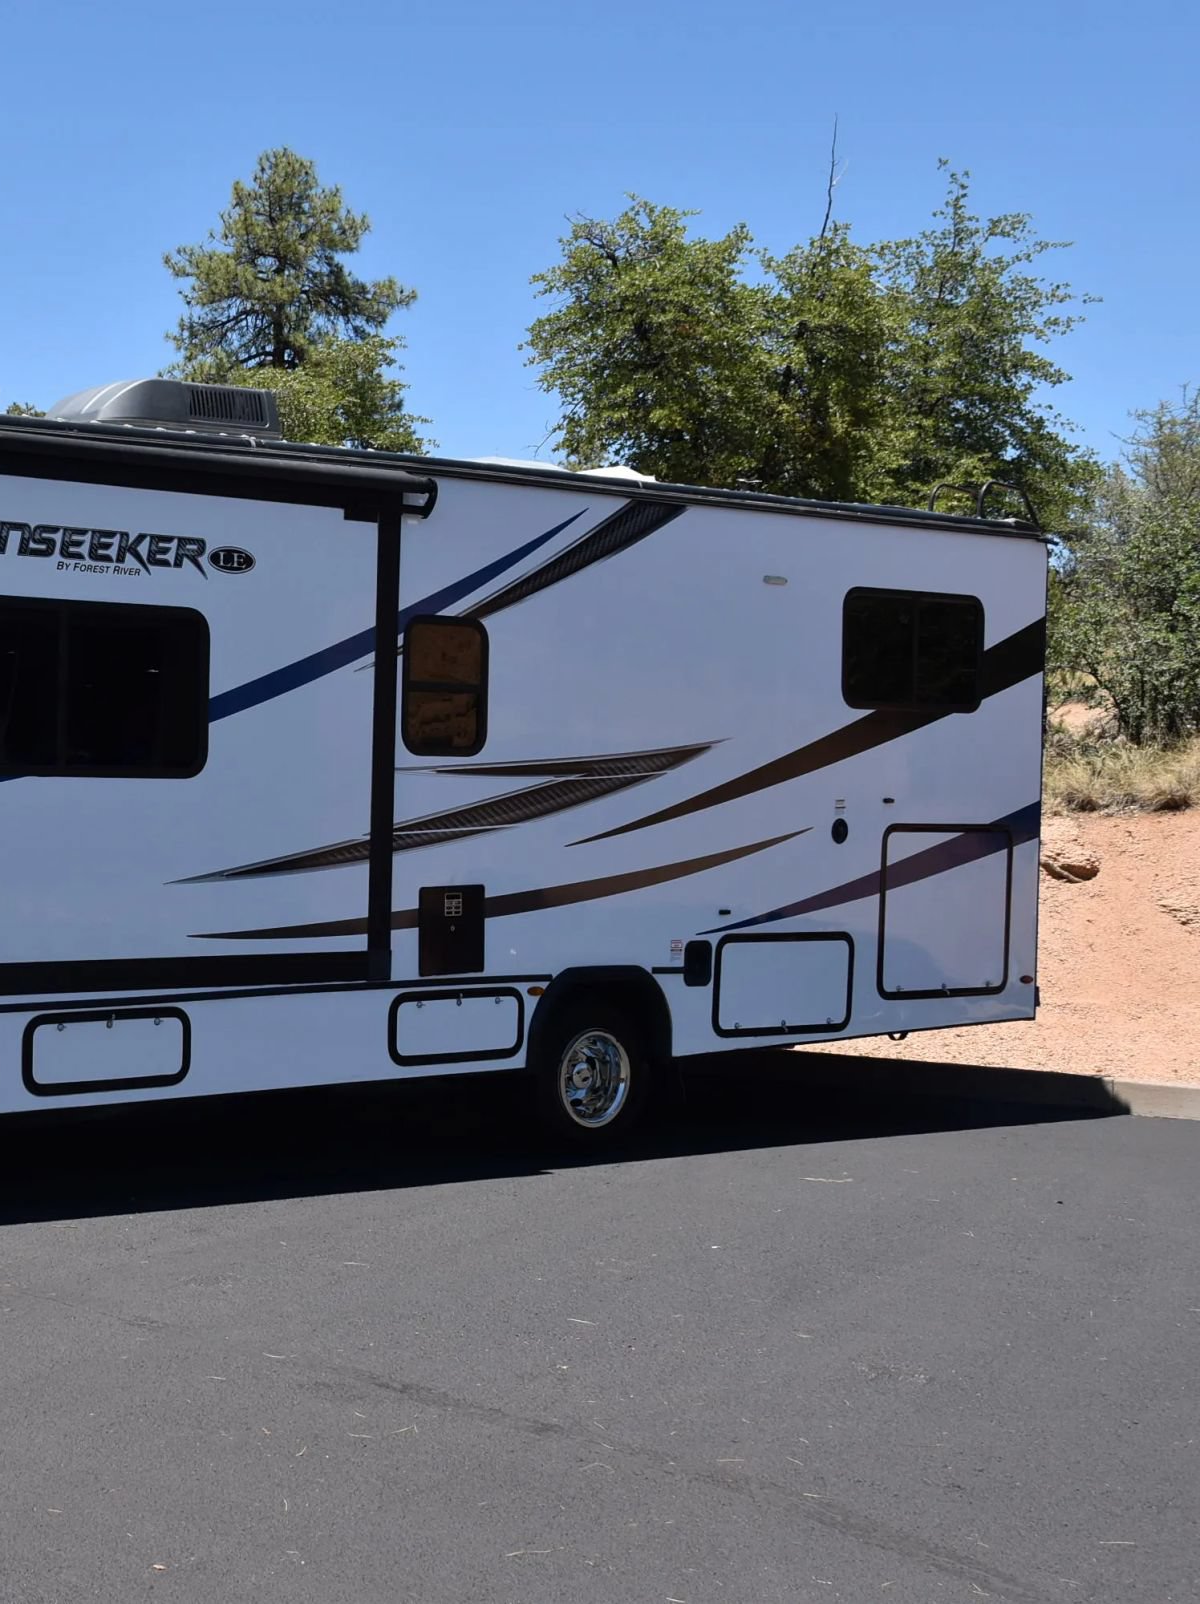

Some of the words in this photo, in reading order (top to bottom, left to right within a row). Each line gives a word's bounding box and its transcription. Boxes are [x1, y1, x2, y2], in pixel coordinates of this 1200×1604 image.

[218, 551, 247, 568] LE
[56, 561, 71, 571] BY
[73, 562, 111, 574] FOREST
[113, 565, 141, 576] RIVER
